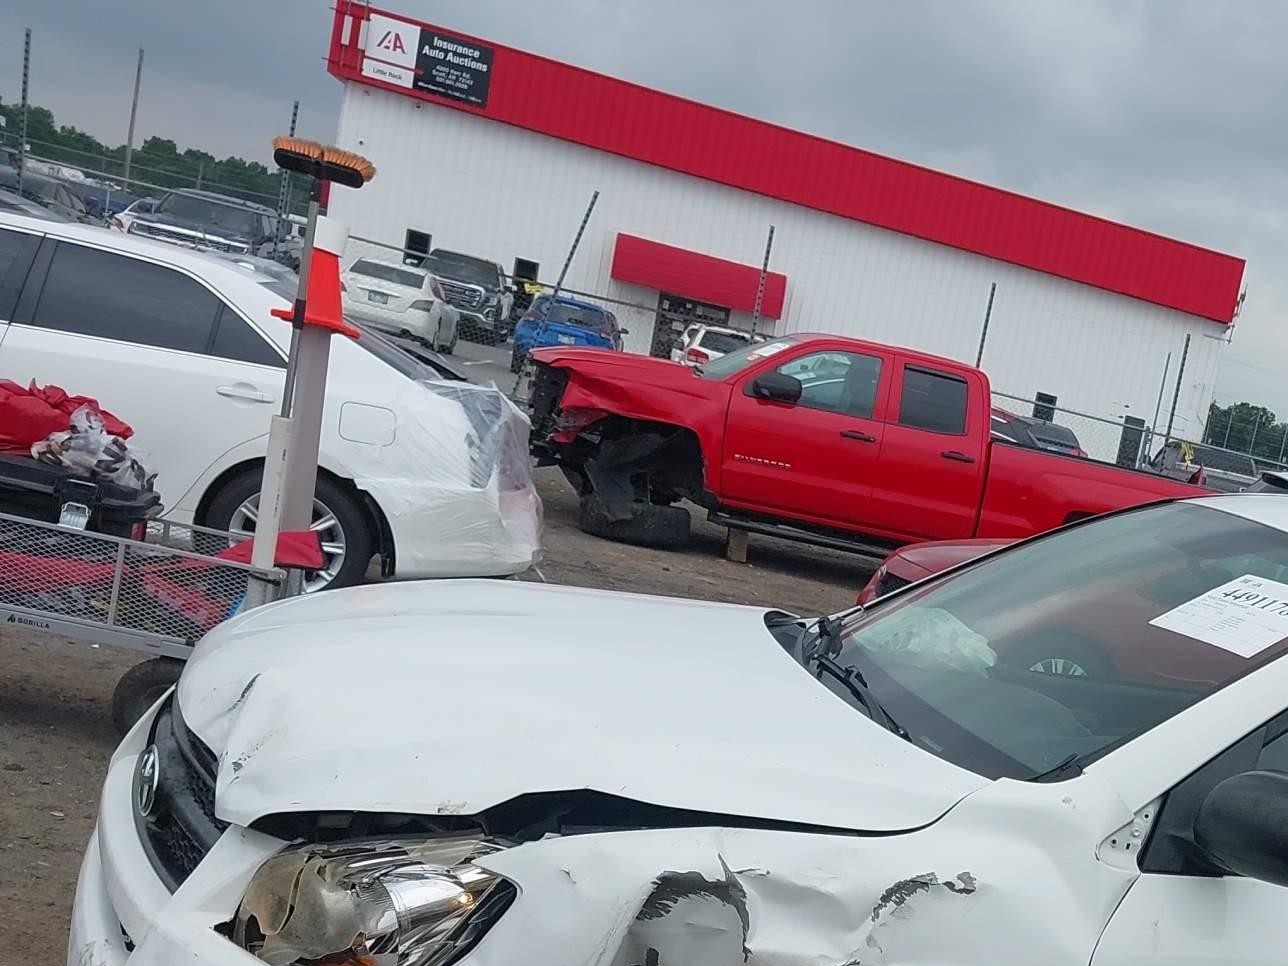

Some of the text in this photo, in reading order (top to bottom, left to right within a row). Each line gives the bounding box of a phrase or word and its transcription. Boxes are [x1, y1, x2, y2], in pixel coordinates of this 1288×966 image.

[422, 45, 489, 72] Auto Auctions
[433, 36, 481, 58] Insurance
